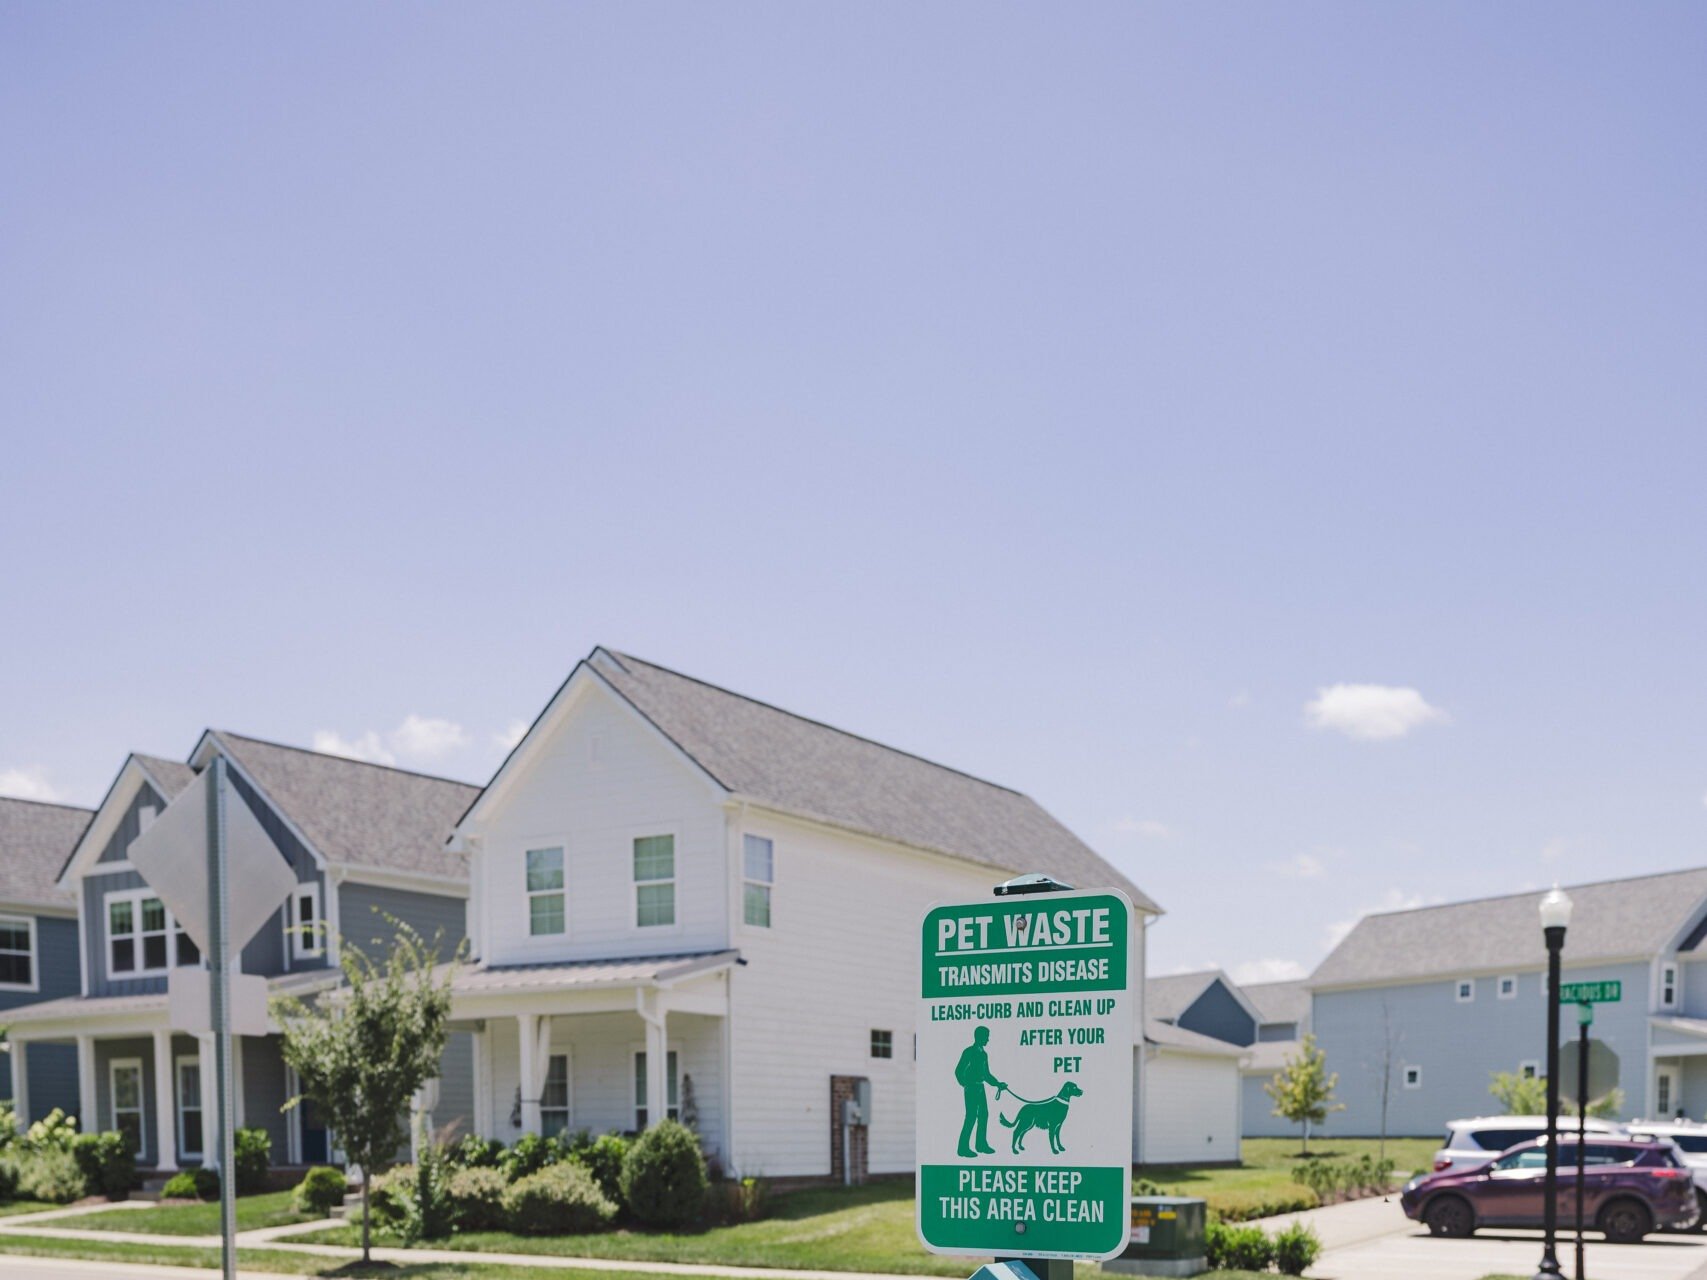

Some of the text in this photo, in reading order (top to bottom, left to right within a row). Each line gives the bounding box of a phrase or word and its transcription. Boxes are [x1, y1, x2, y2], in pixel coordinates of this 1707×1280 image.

[938, 908, 1110, 951] PET WASTE
[938, 958, 1109, 987] TRANSMITS DISEASE
[931, 998, 1116, 1021] LEASH-CURB AND CLEAN UP
[1020, 1027, 1105, 1047] AFTER YOUR
[1053, 1057, 1082, 1073] PET
[959, 1170, 1082, 1194] PLEASE KEEP
[939, 1197, 1104, 1224] THIS AREA CLEAN
